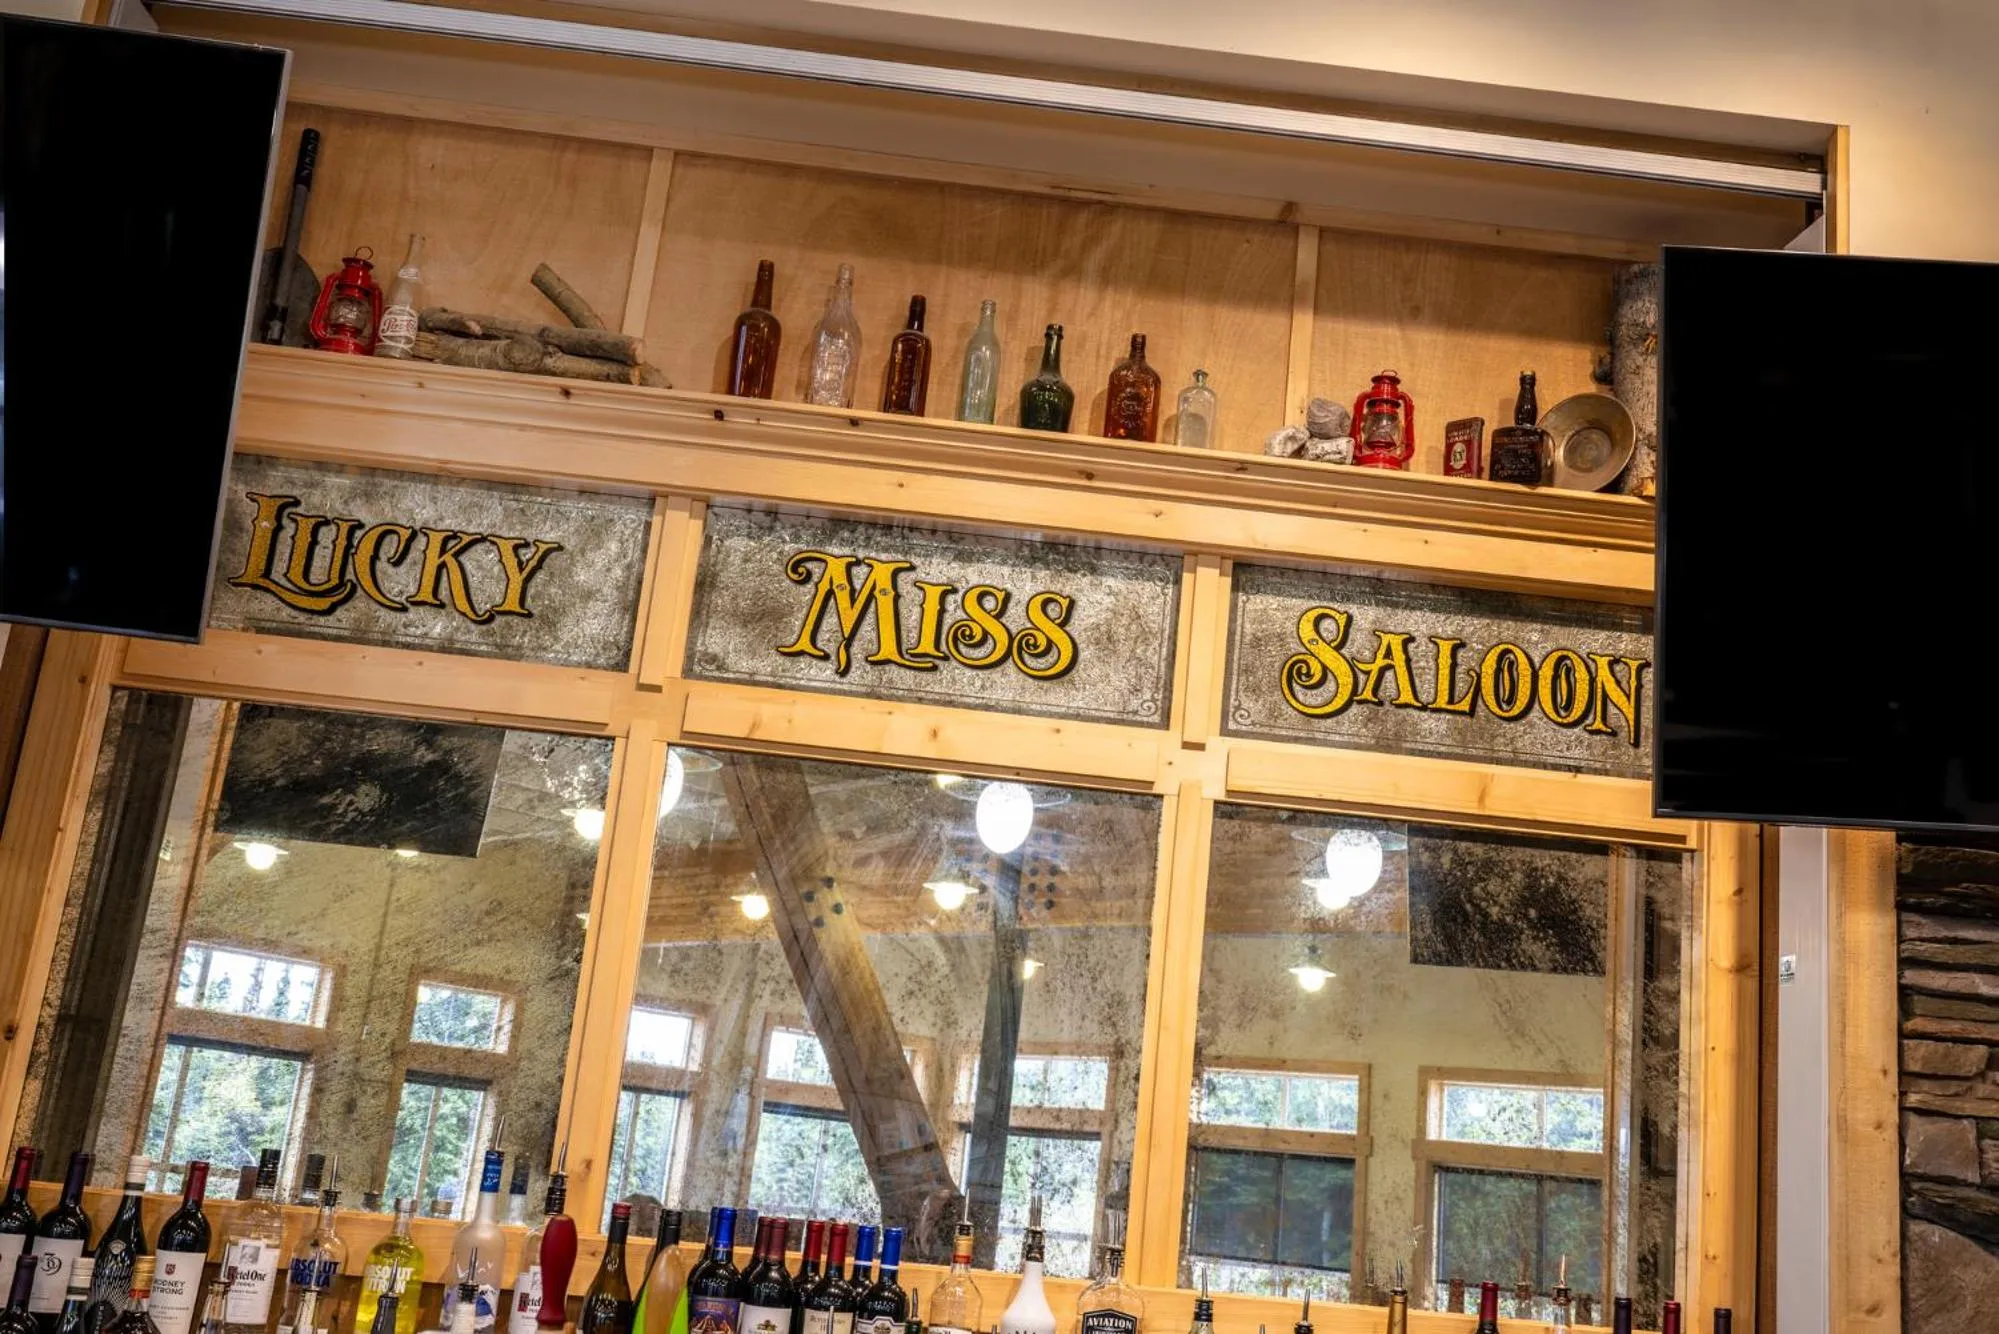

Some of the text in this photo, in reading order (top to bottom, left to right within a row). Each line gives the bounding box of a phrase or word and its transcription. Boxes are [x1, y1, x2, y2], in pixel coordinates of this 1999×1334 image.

[229, 491, 1651, 748] LUCKY MISS SALOON
[1086, 1317, 1133, 1329] AVIATION
